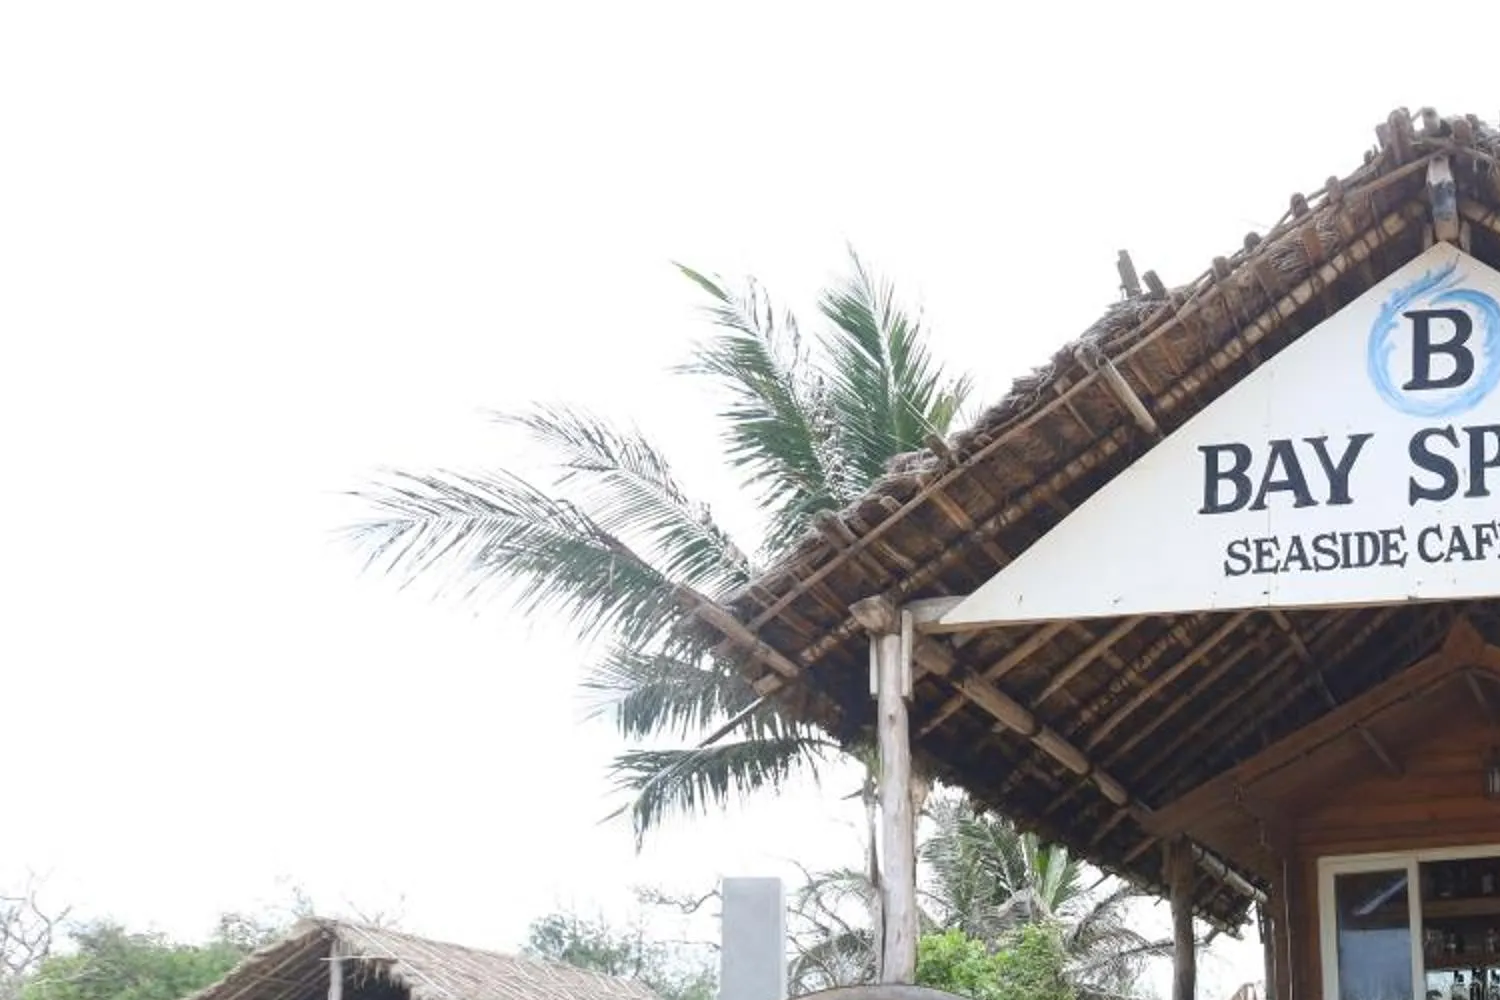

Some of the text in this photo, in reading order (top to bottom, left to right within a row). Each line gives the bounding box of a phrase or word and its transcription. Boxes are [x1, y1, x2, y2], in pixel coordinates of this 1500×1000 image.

[1402, 309, 1475, 390] B
[1198, 433, 1374, 515] BAY
[1224, 526, 1408, 576] SEASIDE
